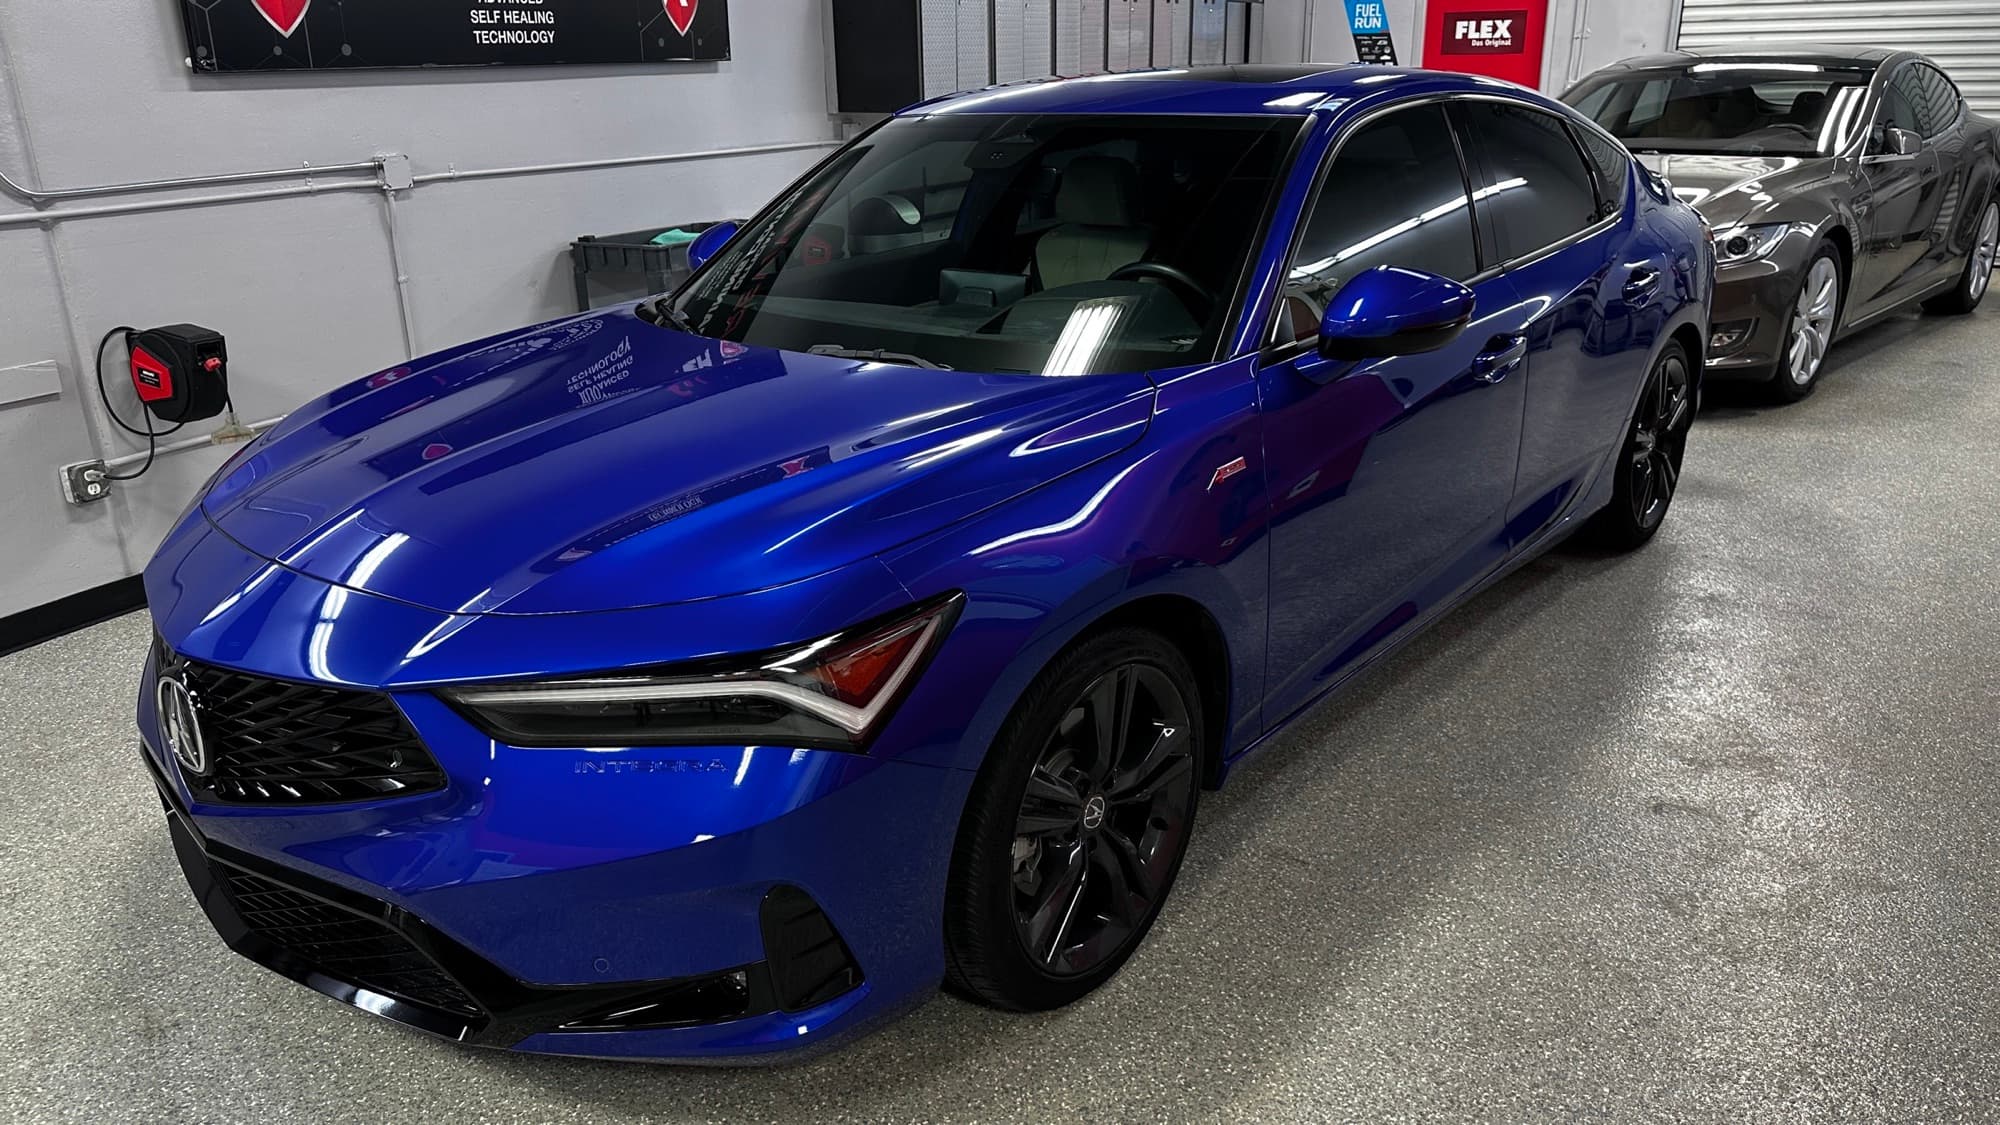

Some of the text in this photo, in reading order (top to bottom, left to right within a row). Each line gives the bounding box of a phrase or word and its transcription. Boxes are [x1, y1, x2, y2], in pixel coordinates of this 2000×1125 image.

[470, 9, 554, 24] SELF HEALING
[1355, 3, 1382, 17] FUEL
[1354, 17, 1382, 29] RUN
[1455, 19, 1513, 40] FLEX
[473, 30, 555, 44] TECHNOLOGY
[1471, 38, 1512, 48] Das Original
